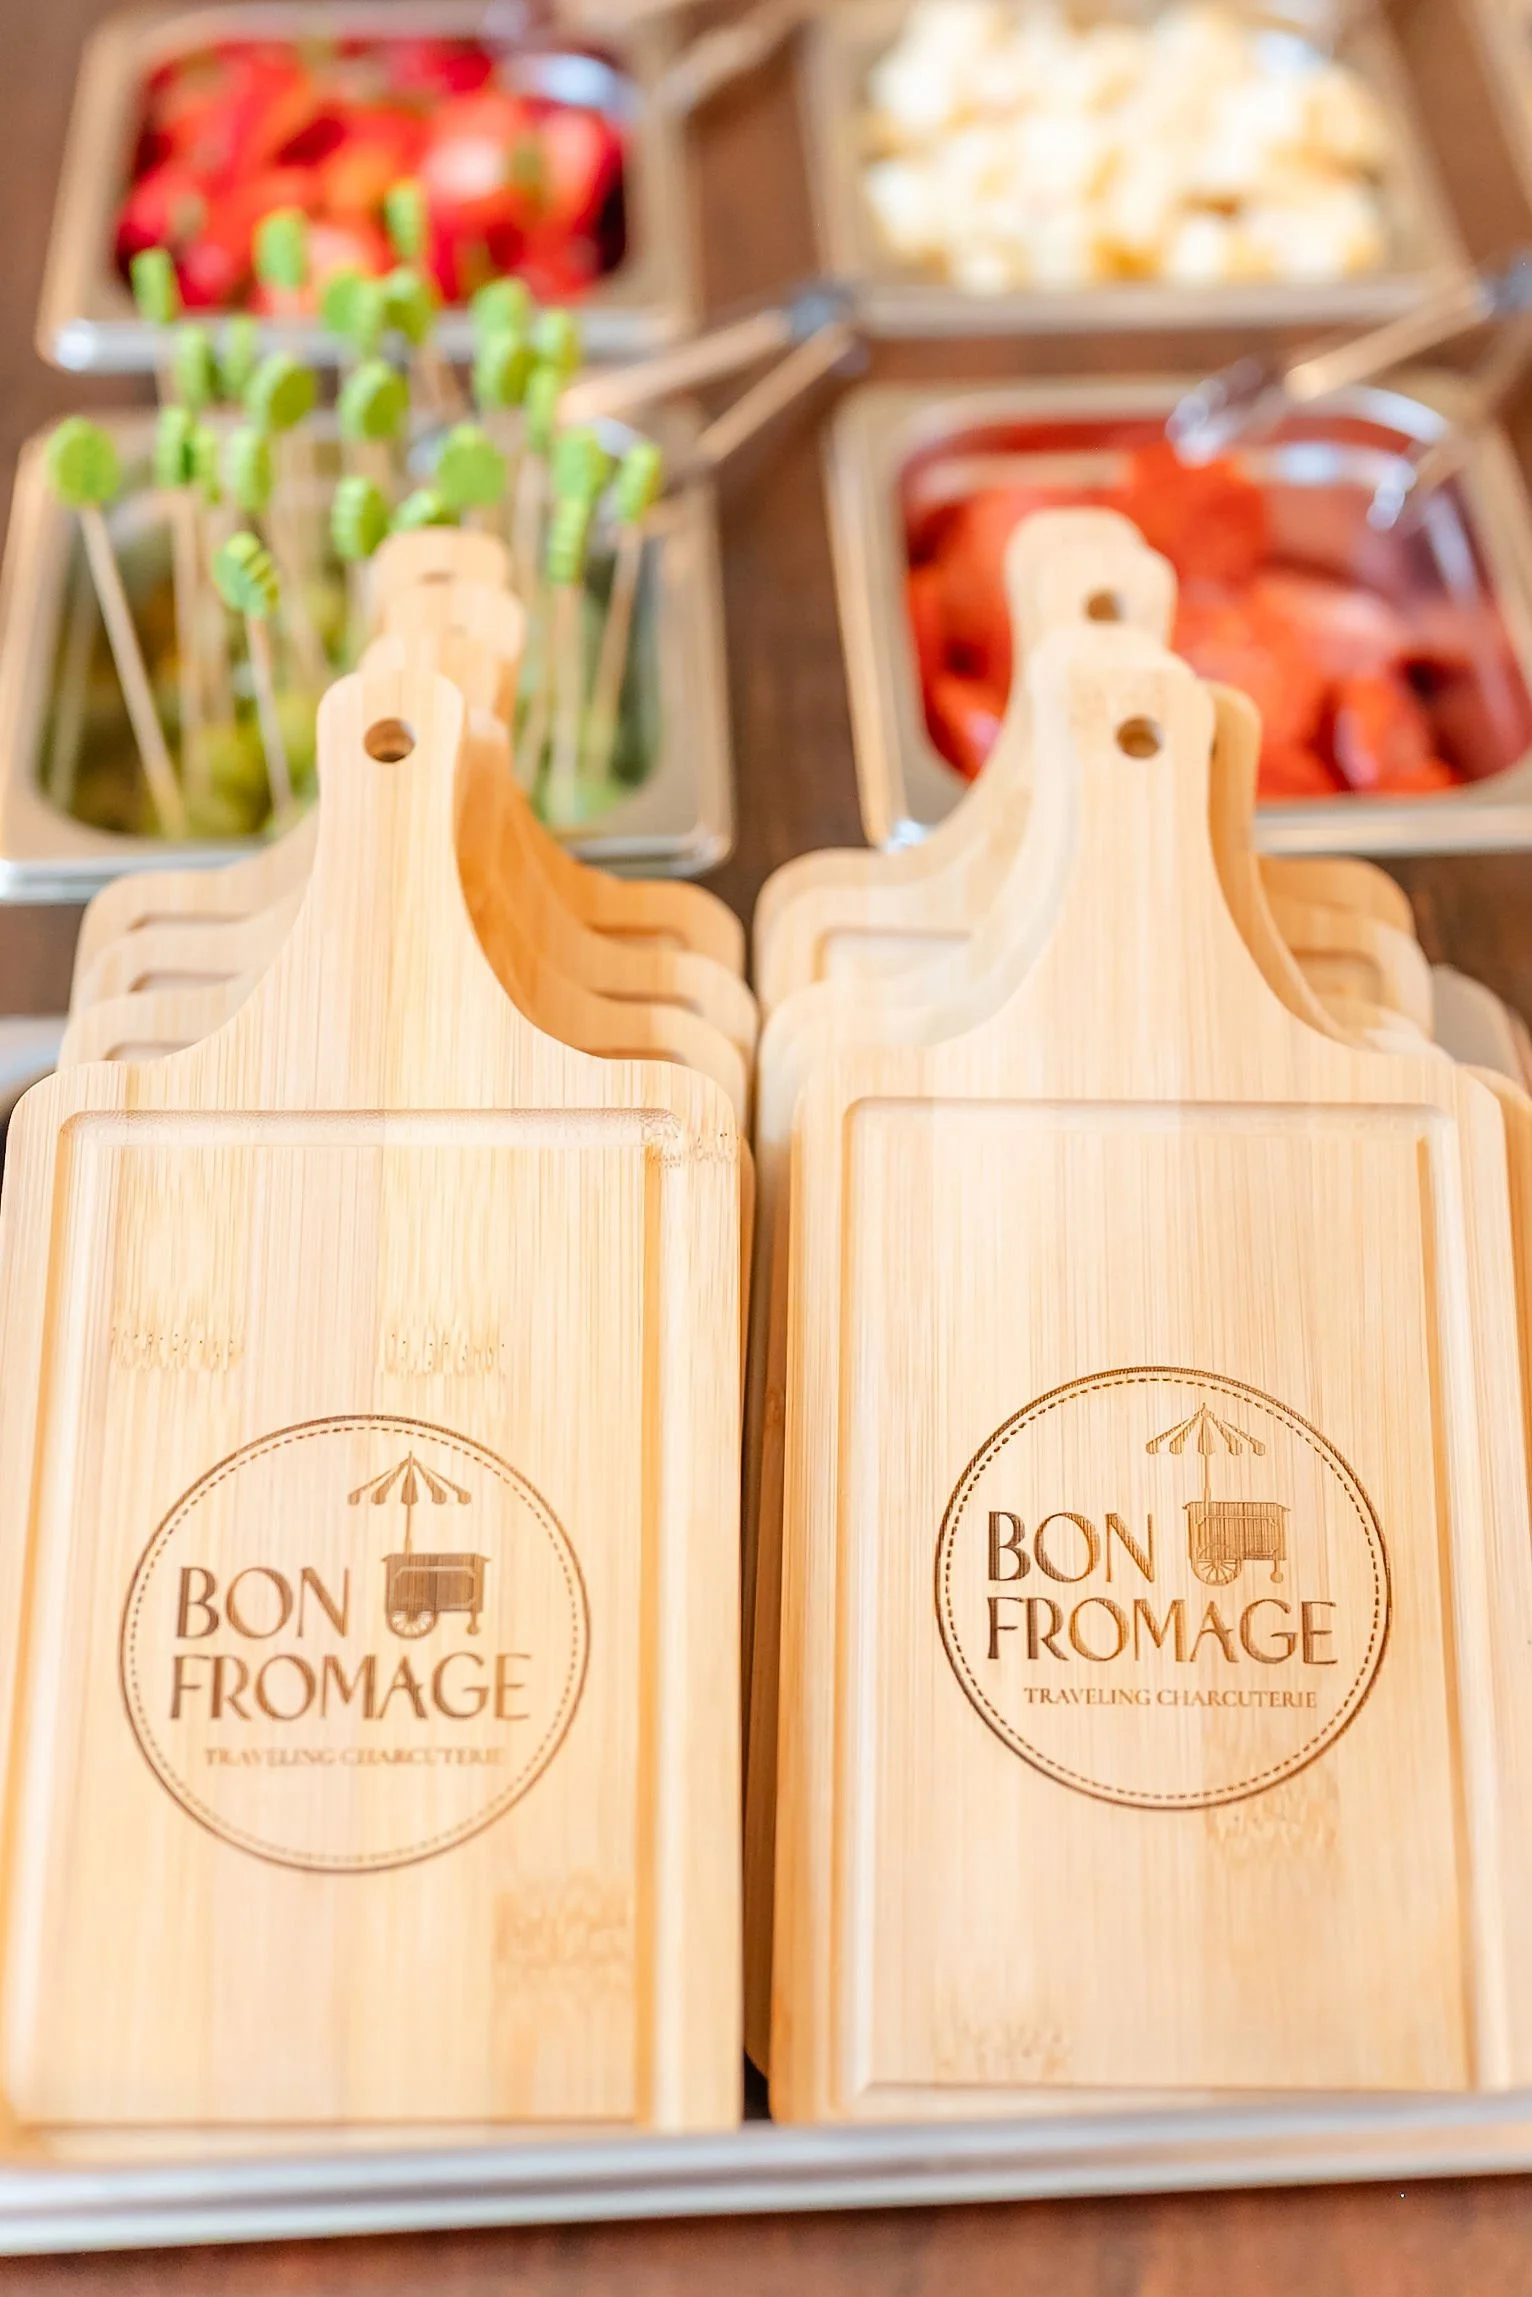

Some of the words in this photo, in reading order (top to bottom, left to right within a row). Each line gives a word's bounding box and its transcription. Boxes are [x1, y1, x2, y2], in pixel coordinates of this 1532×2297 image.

[987, 1510, 1156, 1582] BON
[175, 1566, 350, 1639] BON
[986, 1596, 1339, 1665] FROMAGE
[170, 1651, 532, 1721] FROMAGE
[1023, 1686, 1152, 1706] TRAVELING
[1156, 1688, 1318, 1709] CHARCUTERIE
[204, 1747, 337, 1768] TRAVELING
[340, 1747, 506, 1768] CHARCUTERIE
